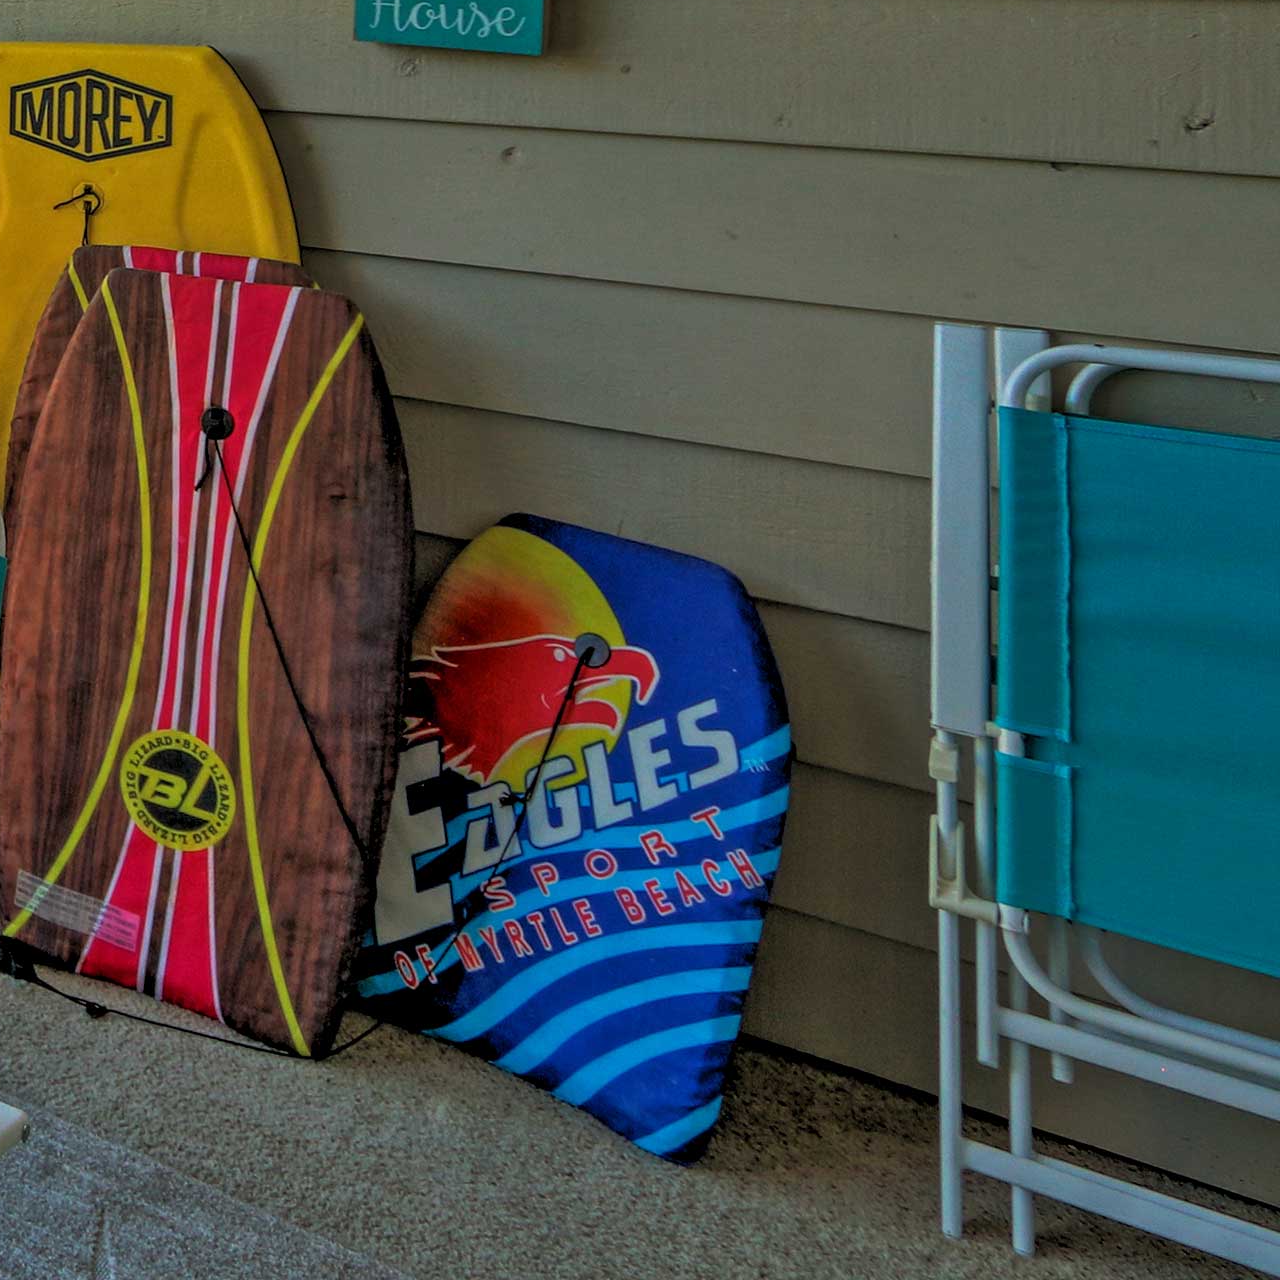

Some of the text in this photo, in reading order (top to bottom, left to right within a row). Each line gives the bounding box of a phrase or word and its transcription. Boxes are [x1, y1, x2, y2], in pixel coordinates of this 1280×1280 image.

[20, 78, 162, 153] MOREY
[126, 735, 173, 799] BIG LIZARD
[182, 739, 230, 824] BIG LIZARD
[137, 809, 218, 844] BIG LIZARD
[481, 806, 724, 912] SPORT
[393, 848, 763, 989] OF MYRTLE BEACH
